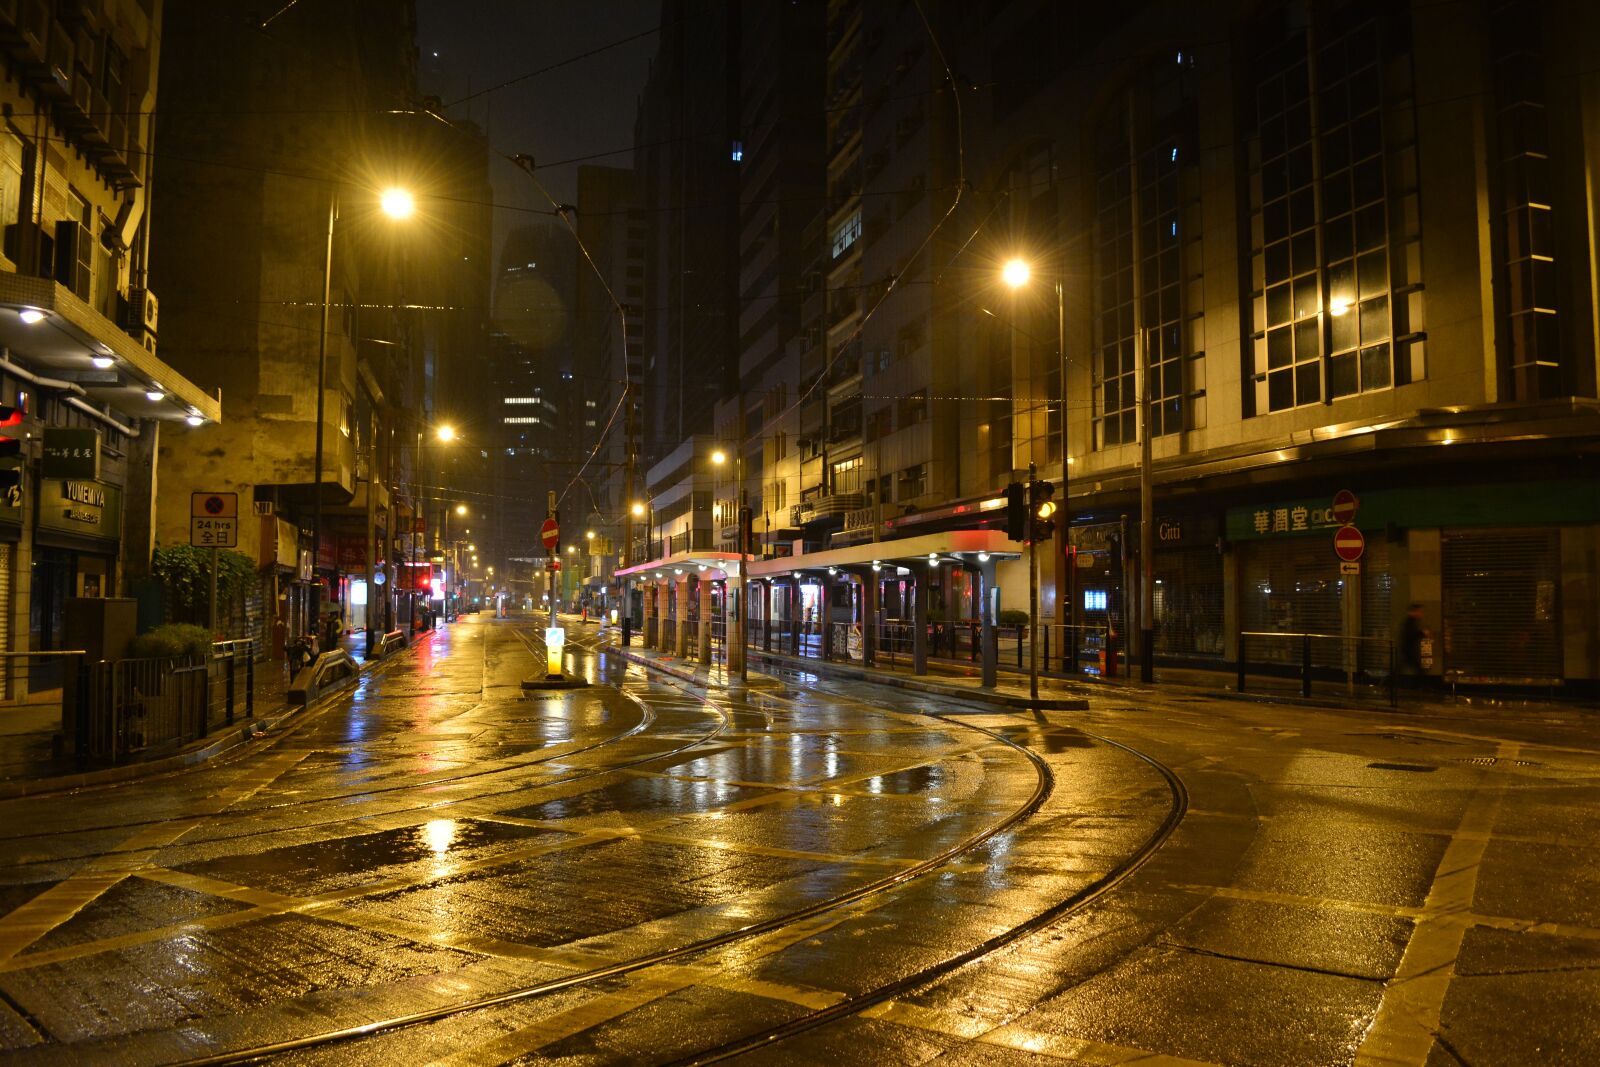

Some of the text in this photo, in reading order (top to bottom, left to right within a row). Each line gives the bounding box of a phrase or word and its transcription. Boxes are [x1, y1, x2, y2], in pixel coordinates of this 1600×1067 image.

[67, 480, 105, 508] YUMEMIYA
[197, 520, 231, 530] 24 hrs
[1253, 506, 1309, 534] 華潤堂
[201, 531, 228, 544] 全日
